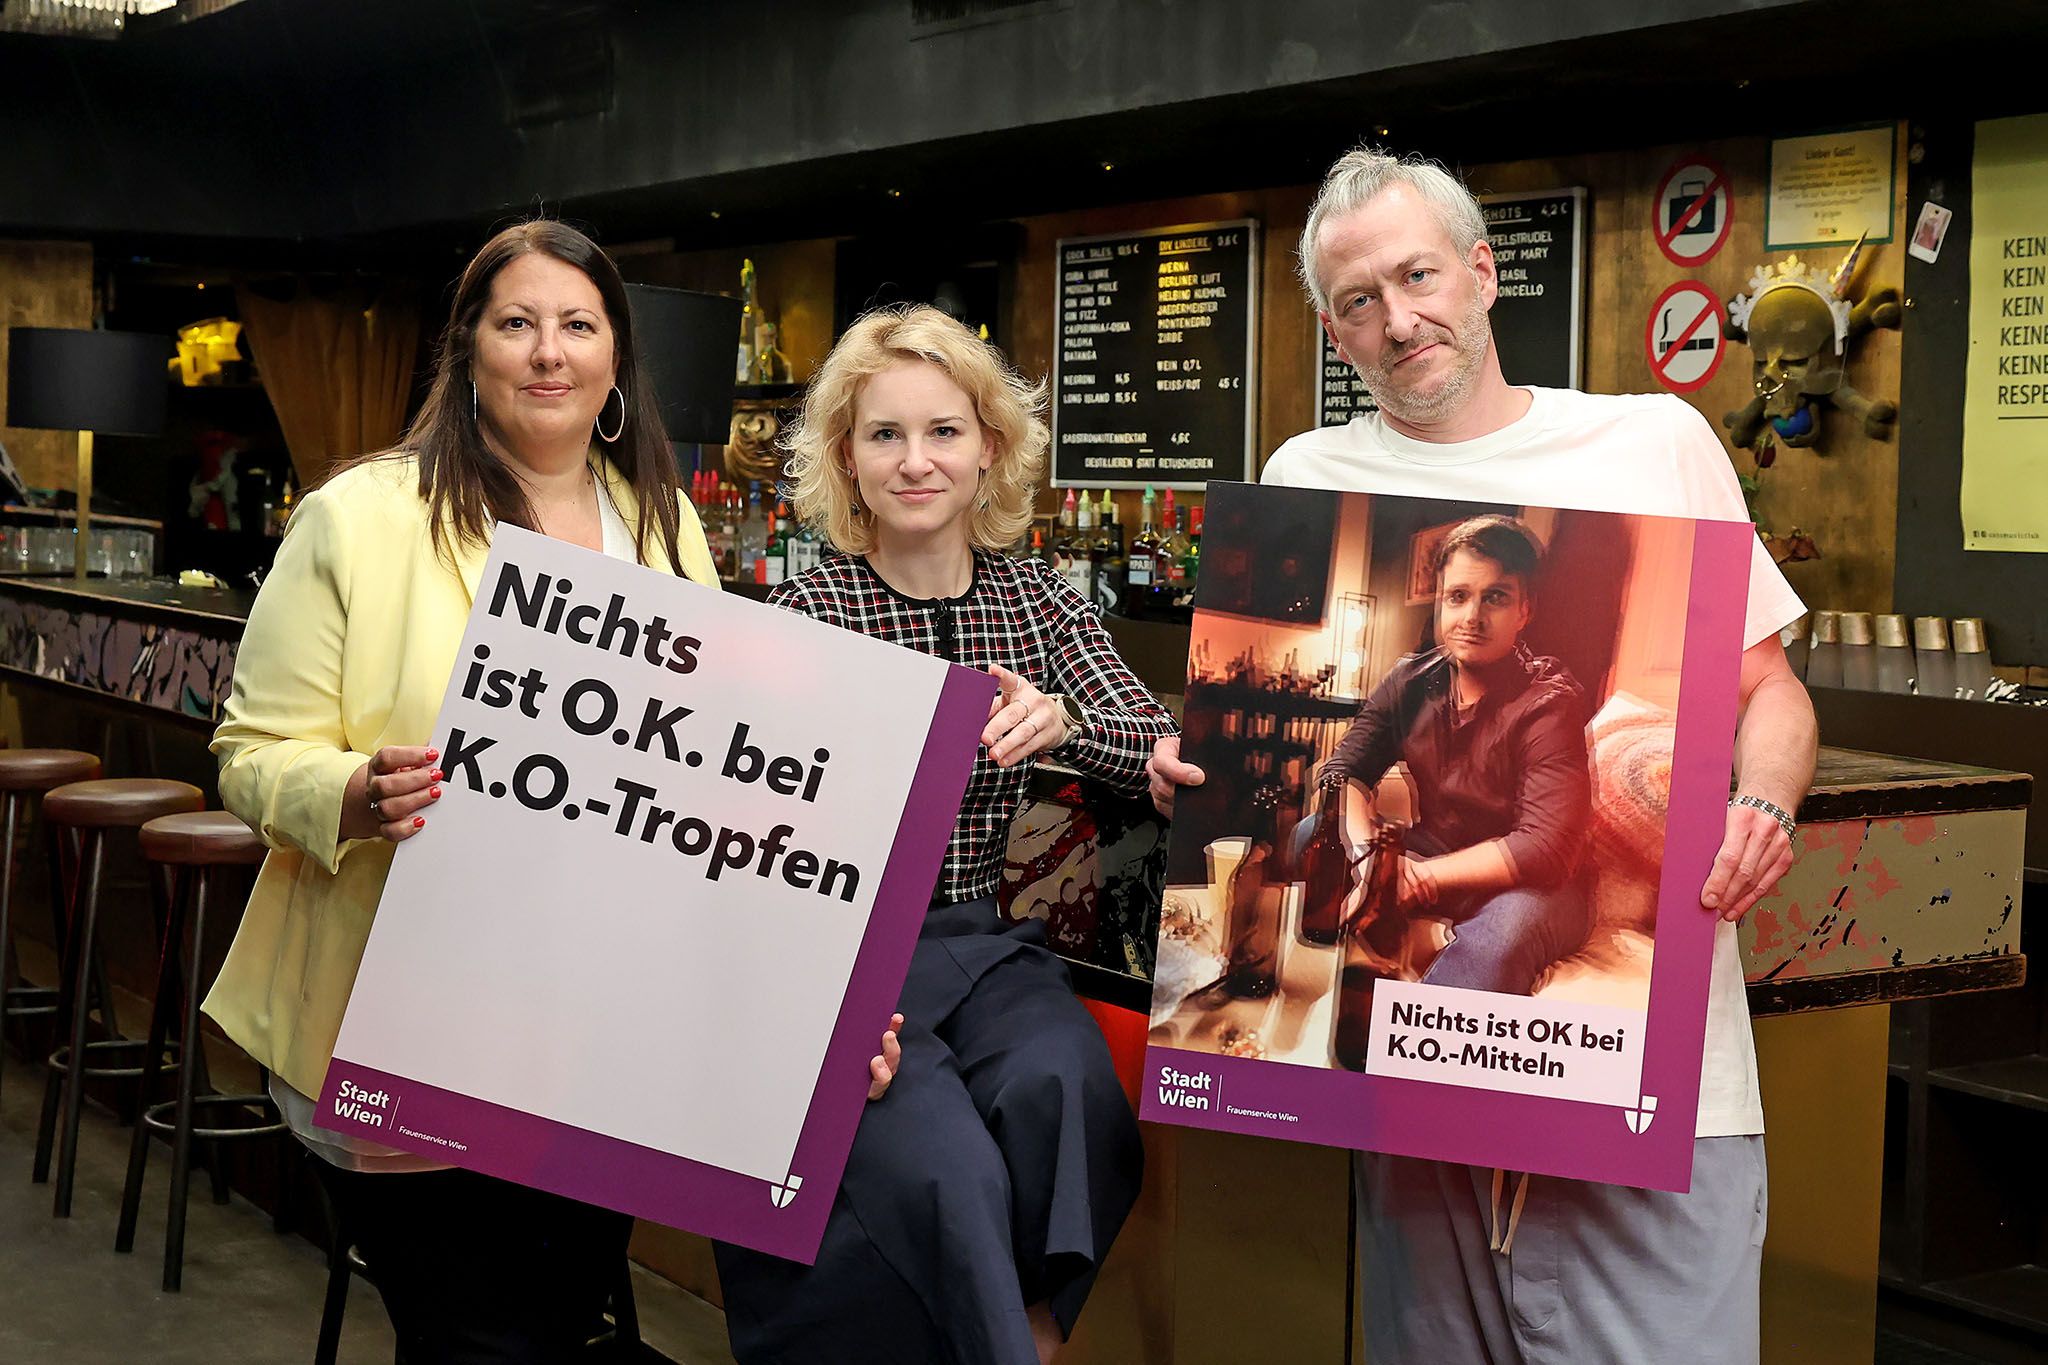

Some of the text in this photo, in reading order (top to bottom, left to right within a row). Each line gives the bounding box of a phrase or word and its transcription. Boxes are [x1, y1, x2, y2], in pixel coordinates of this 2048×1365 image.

[1488, 231, 1552, 247] PFELSTRUDEL
[1493, 248, 1549, 262] OODY MARY
[2004, 237, 2048, 259] KEIN
[1158, 276, 1198, 288] BERLINER
[1500, 269, 1528, 281] BASIL
[1498, 284, 1544, 297] ONCELLO
[1079, 310, 1097, 320] FIZZ
[1158, 316, 1211, 329] MONTENEGRO
[1064, 338, 1093, 348] PALOMA
[1156, 360, 1178, 372] WEIN
[1325, 366, 1348, 377] COLA
[1325, 380, 1369, 392] ROTE TRA
[1325, 396, 1376, 407] APFEL ING
[1998, 384, 2048, 405] RESPE
[1325, 411, 1347, 422] PINK
[487, 562, 700, 674] Nichts
[461, 644, 830, 802] ist O.K. bei
[439, 727, 859, 903] K.O.-Tropfen
[1391, 1002, 1624, 1052] Nichts ist OK bei
[1387, 1035, 1565, 1078] K.O.-Mitteln
[1160, 1066, 1212, 1091] Stadt
[338, 1080, 390, 1109] Stadt
[1159, 1080, 1208, 1110] Wien
[334, 1099, 384, 1127] Wien
[1226, 1106, 1298, 1122] Frauenservice Wien
[399, 1126, 467, 1151] Frauenservice Wien
